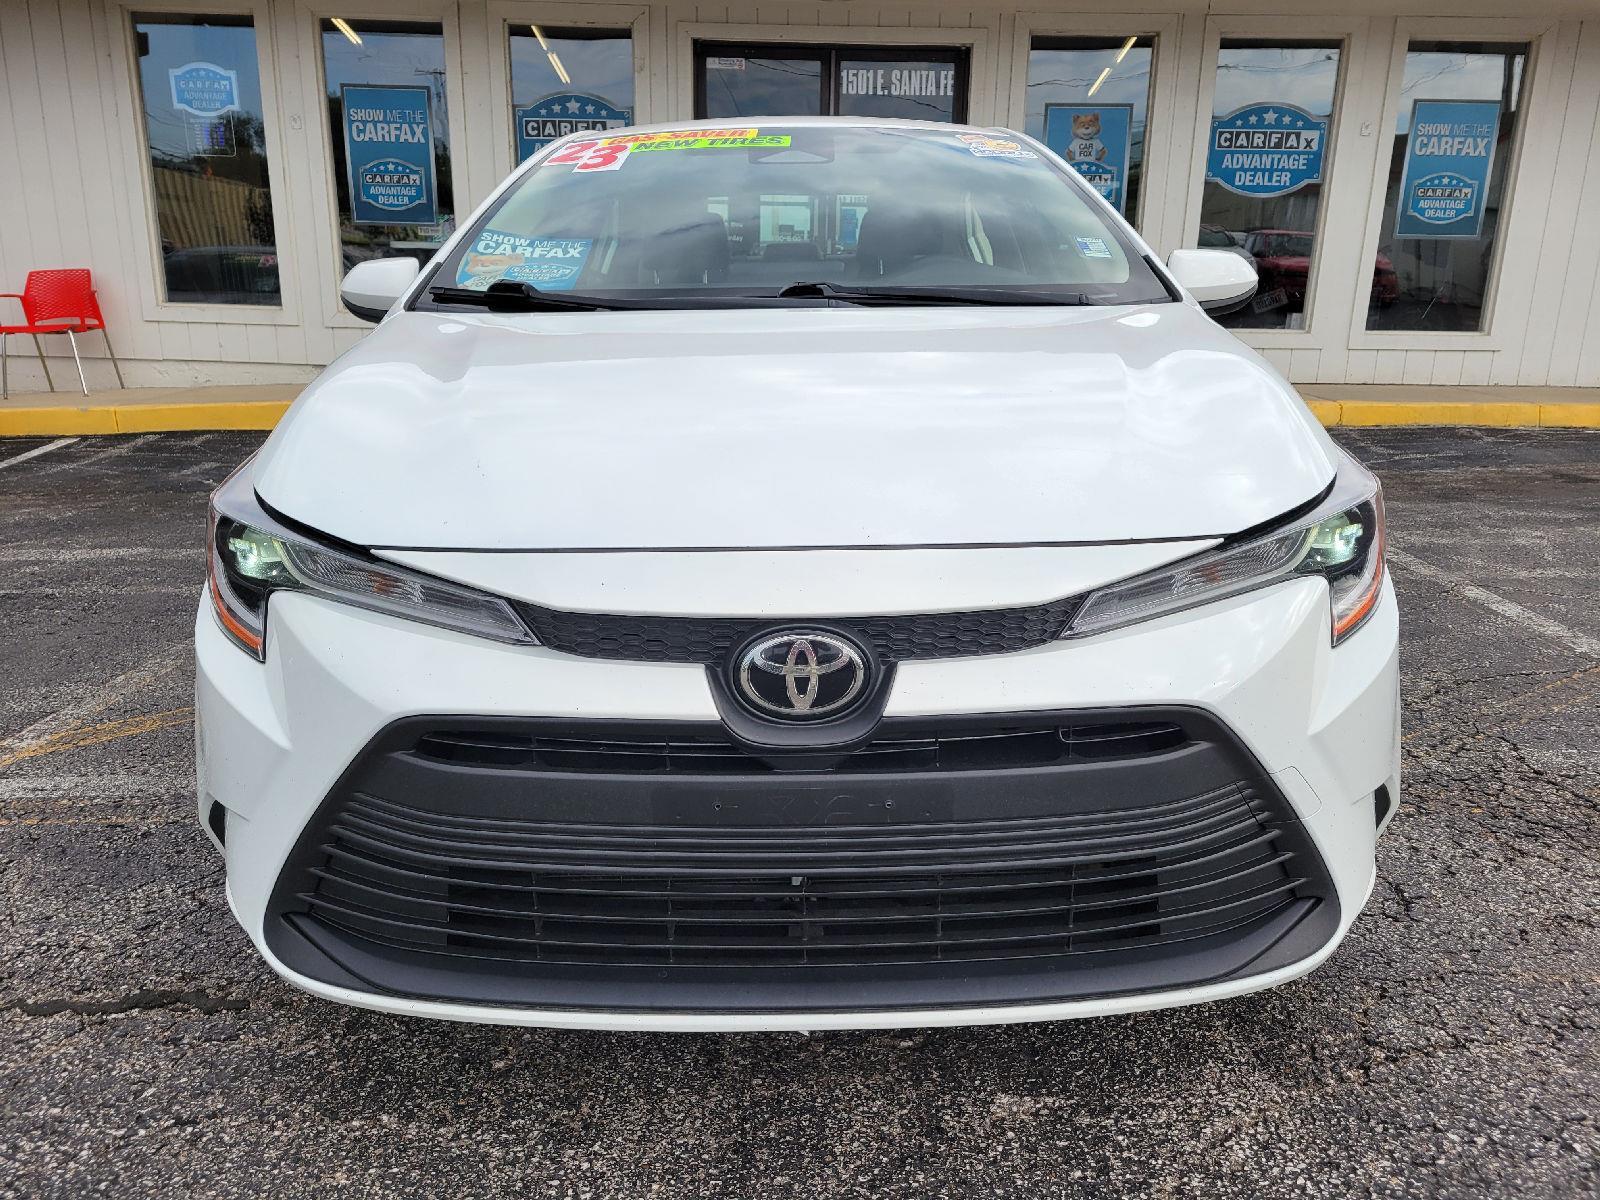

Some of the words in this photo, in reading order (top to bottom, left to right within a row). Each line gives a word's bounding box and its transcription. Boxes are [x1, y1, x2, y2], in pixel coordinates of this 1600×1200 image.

[841, 69, 876, 95] 1501
[877, 69, 889, 95] E.
[891, 69, 937, 96] SANTA
[940, 70, 955, 96] FE
[350, 108, 384, 121] SHOW
[386, 109, 403, 122] ME
[403, 110, 425, 123] THE
[351, 121, 427, 144] CARFAX
[1417, 123, 1451, 136] SHOW
[1453, 123, 1470, 136] ME
[1471, 123, 1492, 137] THE
[634, 138, 700, 150] NEW
[707, 135, 786, 146] TIRES
[1219, 131, 1314, 150] CARFAX
[1415, 136, 1491, 157] CARFAX
[547, 142, 628, 170] 23
[1221, 153, 1308, 170] ADVANTAGE
[365, 174, 419, 185] CARFAX
[1234, 171, 1292, 186] DEALER
[369, 185, 417, 196] ADVANTAGE
[1417, 188, 1470, 199] CARFAX
[378, 195, 409, 205] DEALER
[1418, 199, 1466, 209] ADVANTAGE
[1425, 209, 1456, 218] DEALER
[481, 232, 531, 247] SHOW
[477, 240, 584, 258] CARFAX
